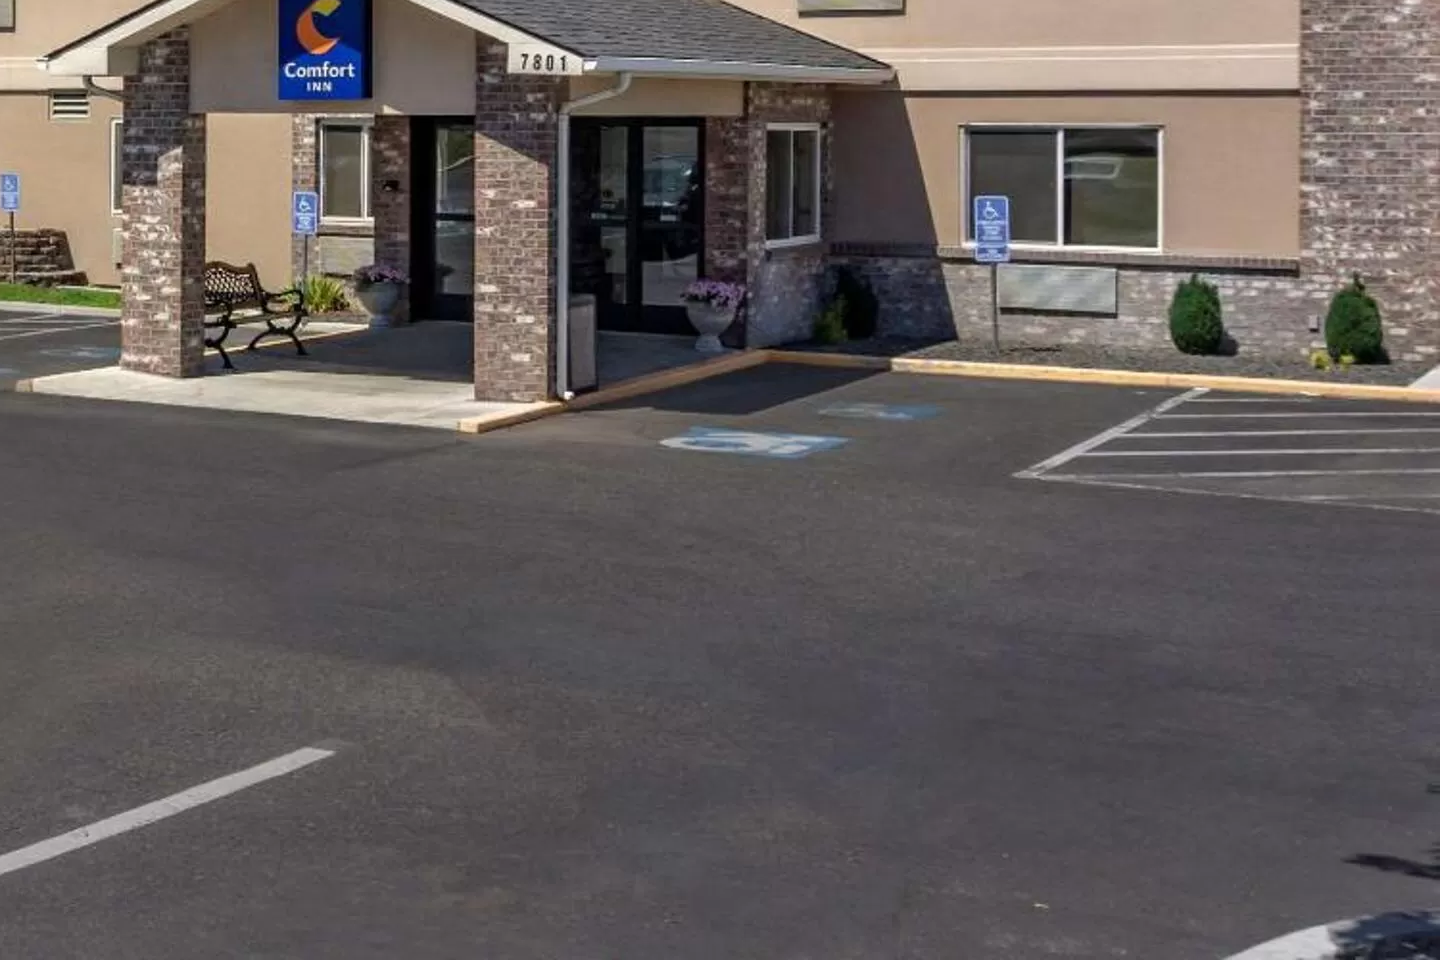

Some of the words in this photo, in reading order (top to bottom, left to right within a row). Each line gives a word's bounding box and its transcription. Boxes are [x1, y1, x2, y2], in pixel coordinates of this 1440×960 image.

[284, 61, 356, 78] Comfort
[520, 52, 567, 72] 7801
[306, 81, 333, 92] INN
